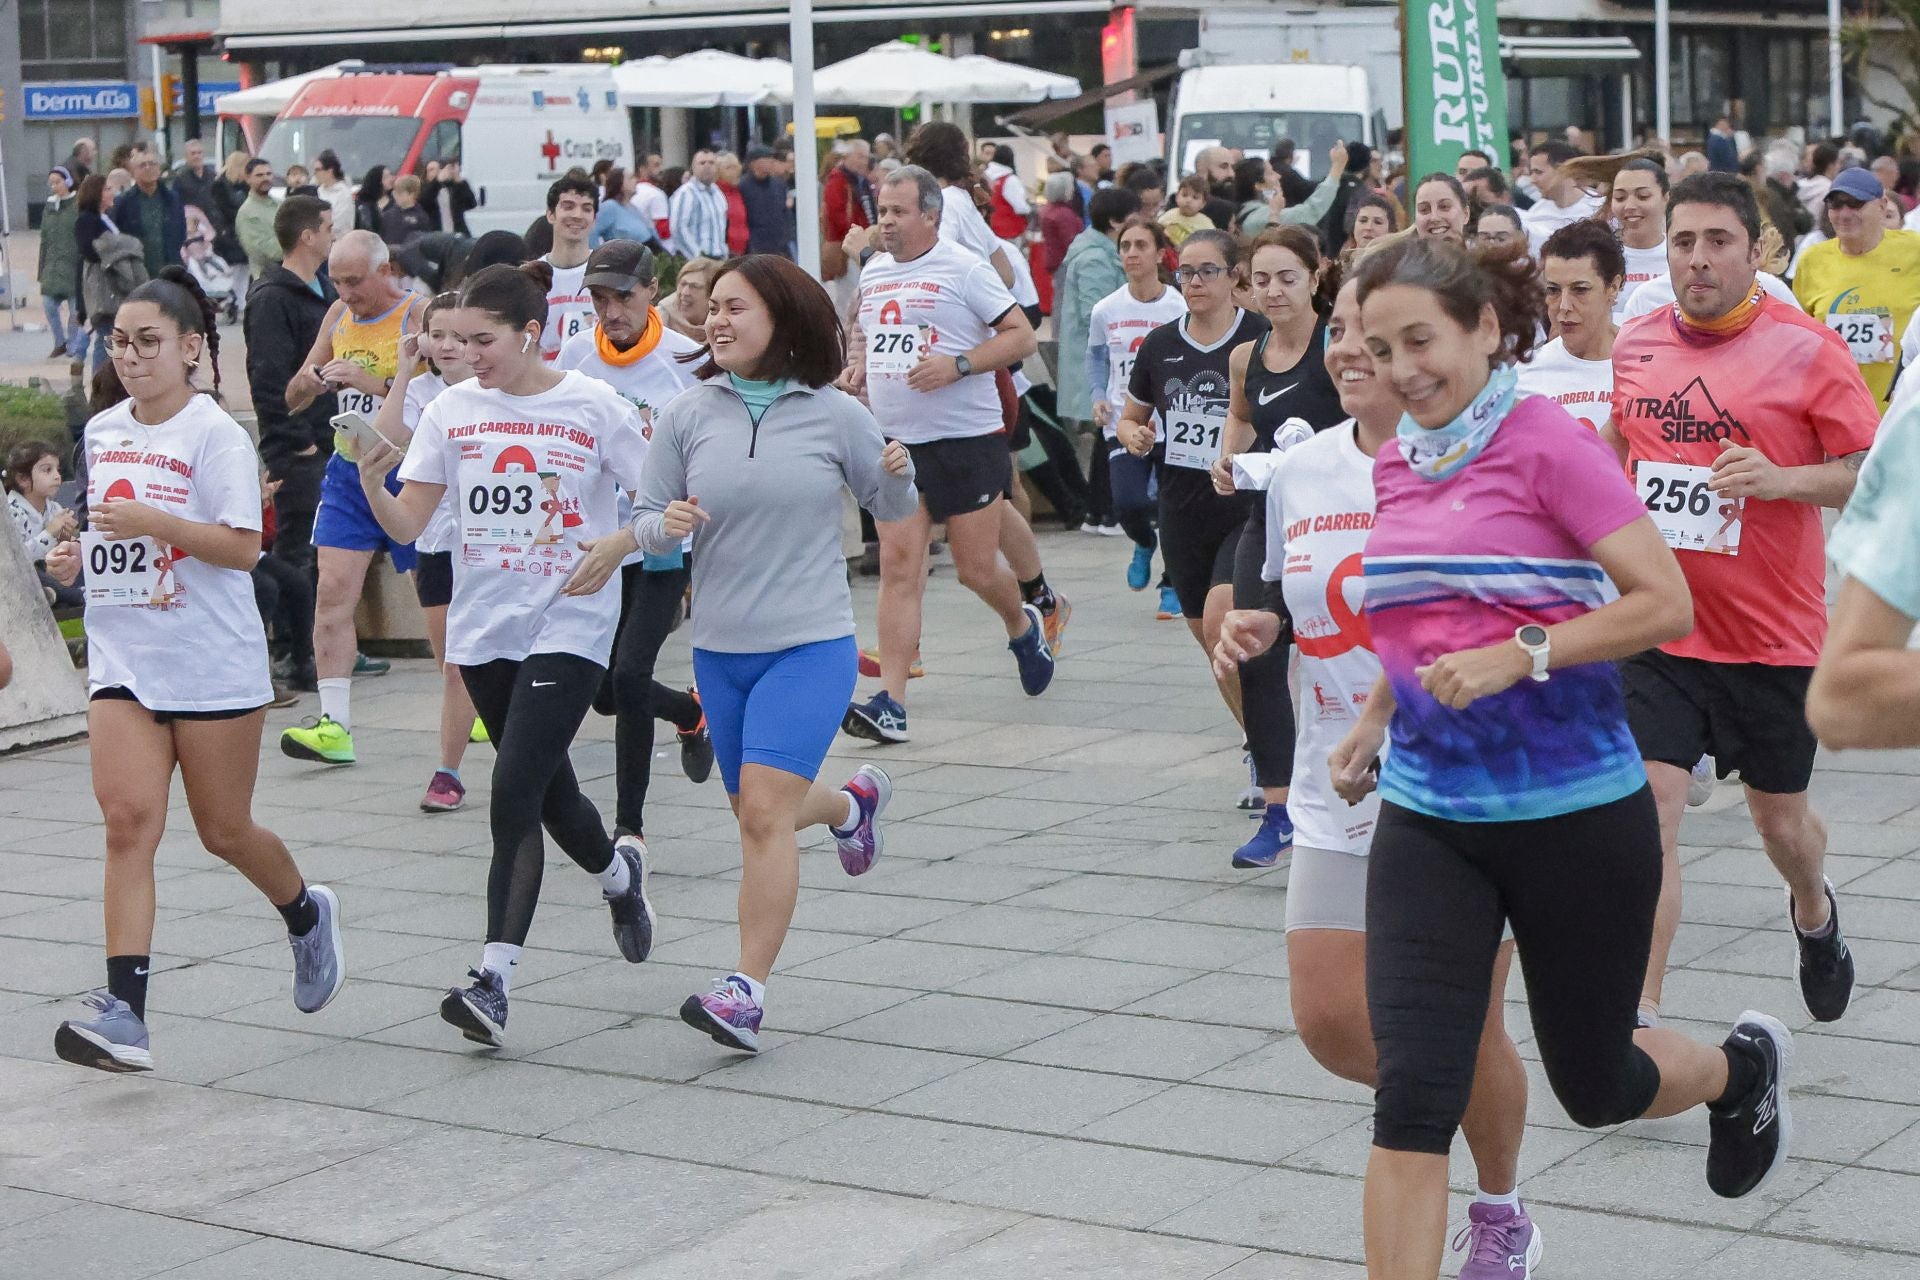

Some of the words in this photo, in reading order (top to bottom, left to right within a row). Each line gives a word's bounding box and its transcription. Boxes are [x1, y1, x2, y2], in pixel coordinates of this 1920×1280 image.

[564, 138, 593, 158] Cruz
[595, 138, 623, 158] Roja
[873, 333, 915, 354] 276
[1198, 381, 1215, 393] edp
[342, 394, 374, 414] 178
[447, 424, 477, 440] XXIV
[479, 421, 534, 436] CARRERA
[537, 423, 596, 450] ANTI-SIDA
[1173, 421, 1221, 449] 231
[1661, 421, 1731, 444] SIERO
[99, 450, 143, 464] CARRERA
[143, 453, 193, 479] ANTI-SIDA
[468, 484, 533, 515] 093
[1644, 477, 1711, 516] 256
[90, 542, 147, 575] 092
